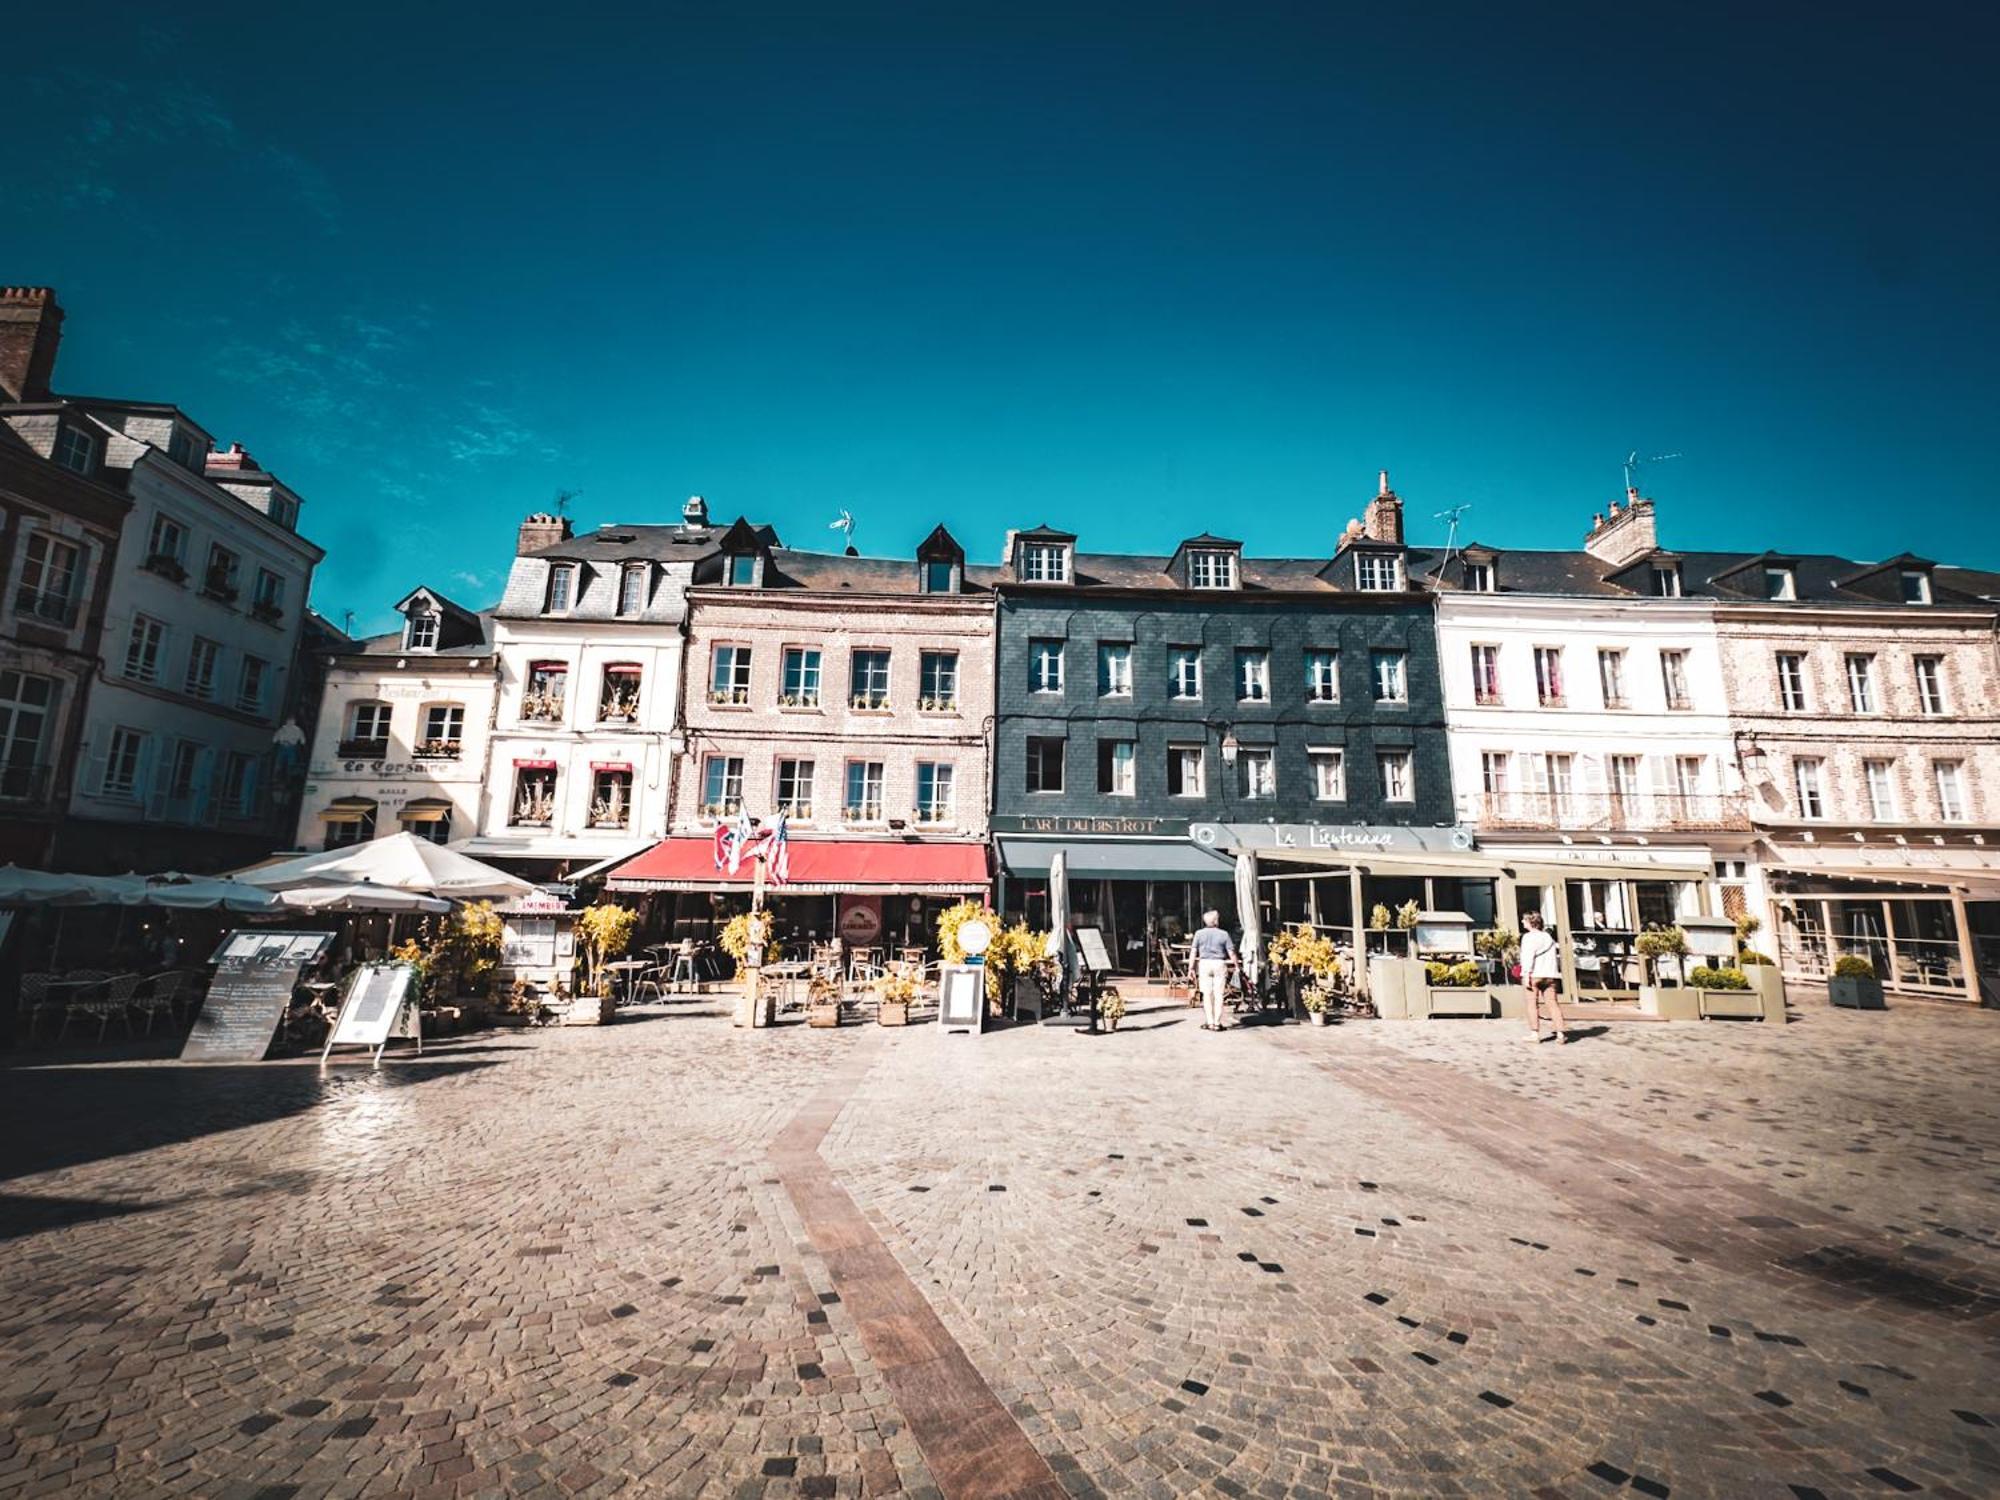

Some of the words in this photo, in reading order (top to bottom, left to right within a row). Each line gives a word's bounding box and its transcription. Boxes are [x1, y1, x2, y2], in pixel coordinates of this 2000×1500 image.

[344, 761, 365, 773] Le
[370, 760, 448, 773] Corsaire
[1066, 820, 1088, 831] DU
[1092, 820, 1155, 833] BISTROT
[1276, 826, 1297, 847] La
[1310, 825, 1394, 848] Lieutenance
[622, 880, 694, 890] RESTAURANT
